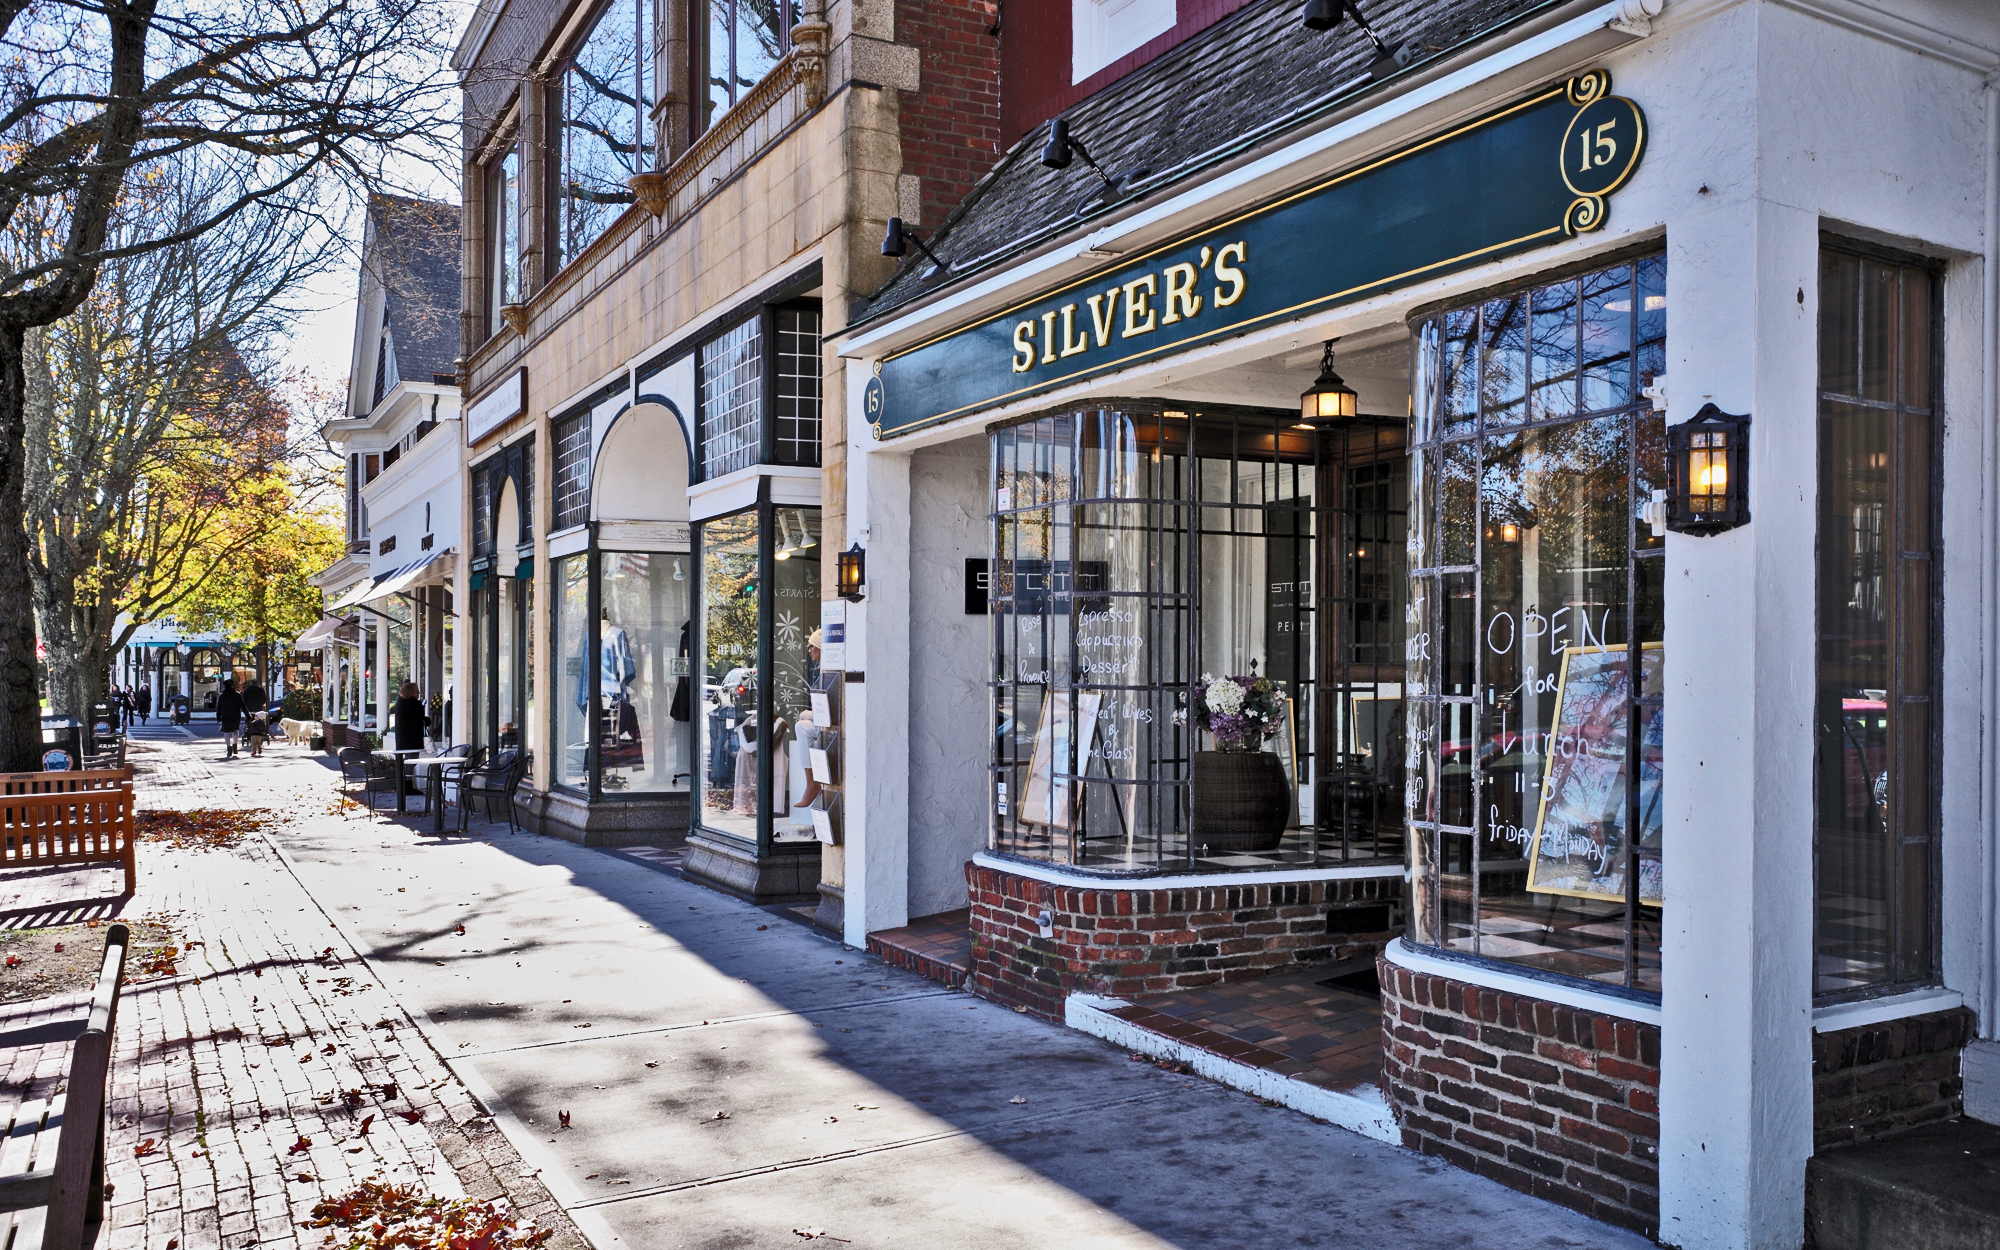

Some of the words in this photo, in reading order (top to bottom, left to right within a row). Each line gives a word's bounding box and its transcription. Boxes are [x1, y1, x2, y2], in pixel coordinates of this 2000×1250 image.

[1579, 117, 1617, 173] 15
[1012, 240, 1247, 374] SILVER'S
[868, 388, 879, 413] 15
[1488, 607, 1610, 655] OPEN
[1082, 654, 1136, 675] Dessert
[1103, 740, 1134, 759] Glass
[1502, 709, 1595, 761] Lunch
